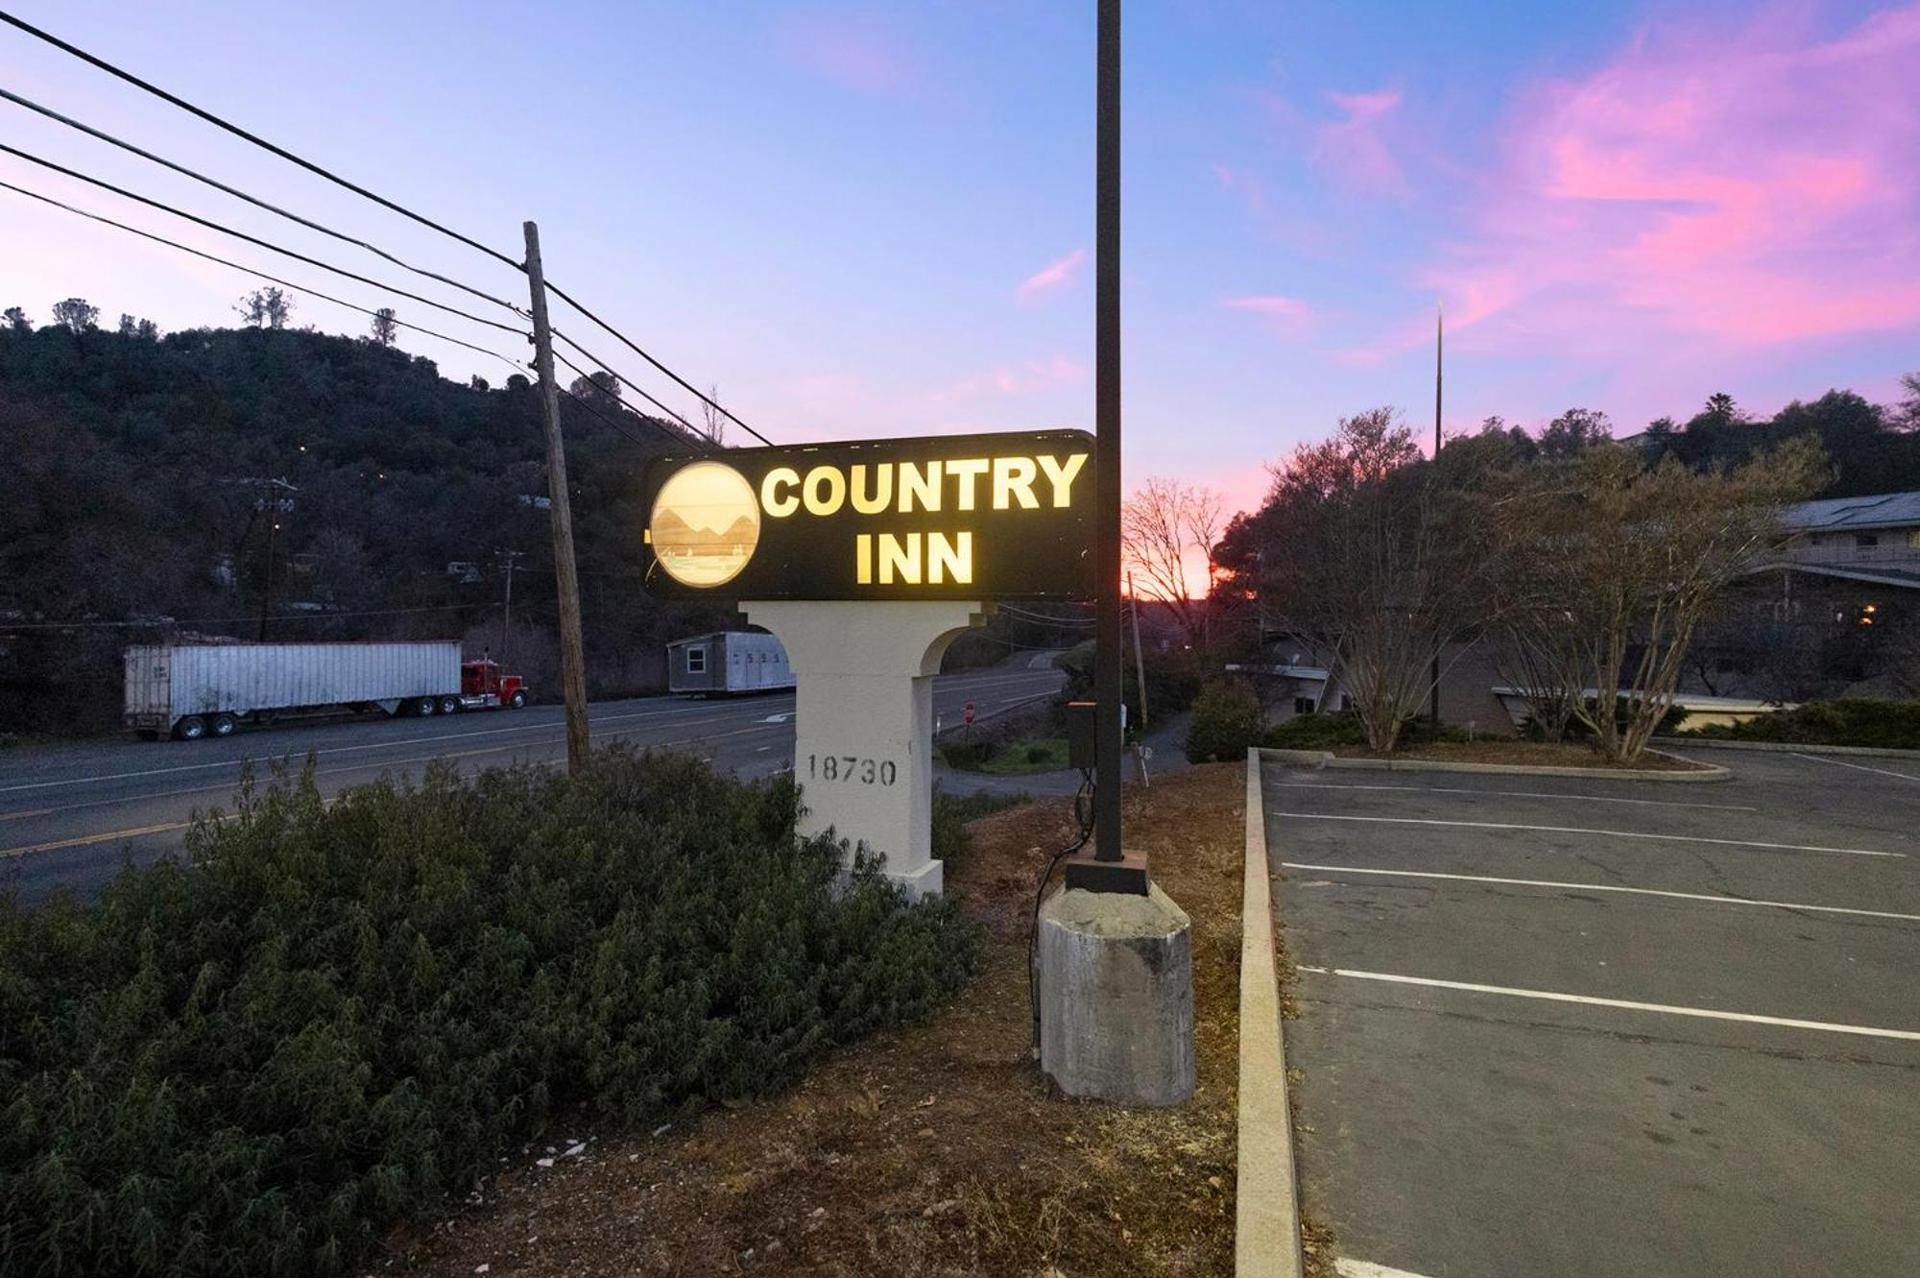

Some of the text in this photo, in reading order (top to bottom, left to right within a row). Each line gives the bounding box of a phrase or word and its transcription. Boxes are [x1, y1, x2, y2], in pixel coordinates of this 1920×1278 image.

[760, 453, 1088, 518] COUNTRY
[856, 531, 973, 585] INN
[808, 754, 896, 786] 18730
